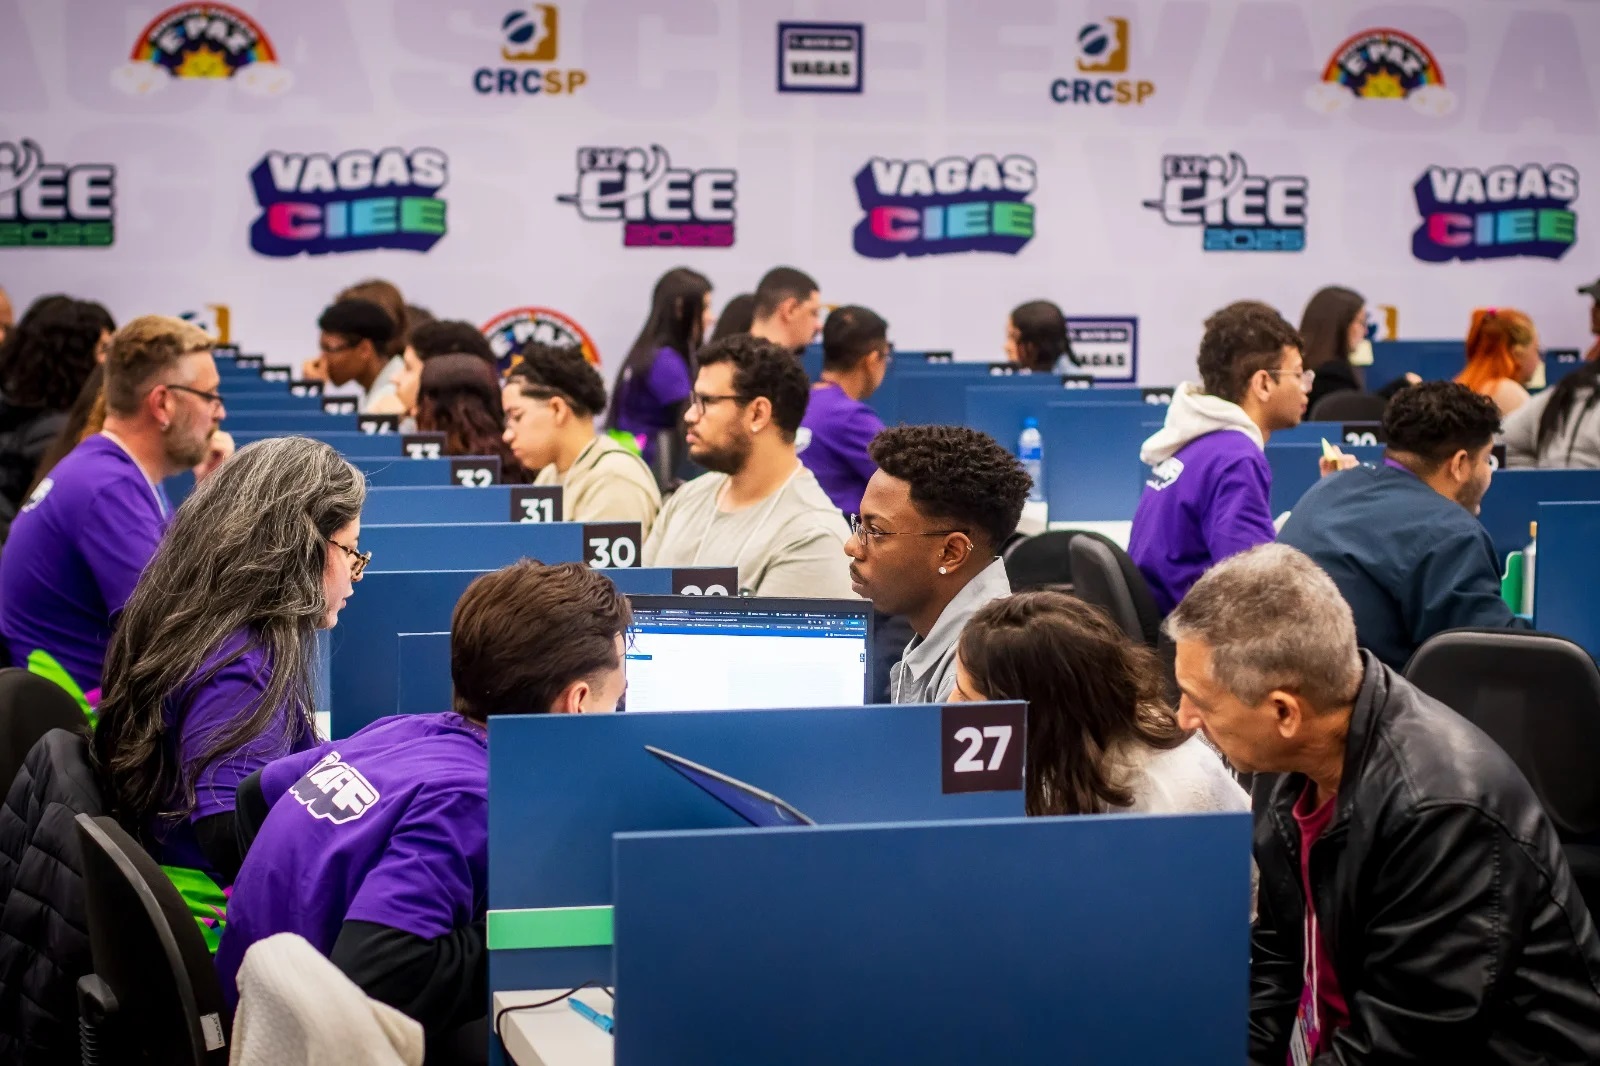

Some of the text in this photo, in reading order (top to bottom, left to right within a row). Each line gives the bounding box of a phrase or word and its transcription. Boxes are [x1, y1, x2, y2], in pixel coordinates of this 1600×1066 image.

[473, 67, 587, 95] CRCSP
[1051, 79, 1155, 104] CRCSP
[264, 148, 448, 193] VAGAS
[868, 155, 1037, 197] VAGAS
[1427, 163, 1579, 204] VAGAS
[578, 168, 737, 221] CIEE
[1163, 176, 1308, 226] CIEE
[267, 196, 447, 241] CIEE
[869, 201, 1035, 243] CIEE
[1428, 207, 1577, 247] CIEE
[456, 468, 493, 488] 32
[520, 498, 554, 524] 31
[588, 536, 636, 569] 30
[953, 725, 1013, 773] 27
